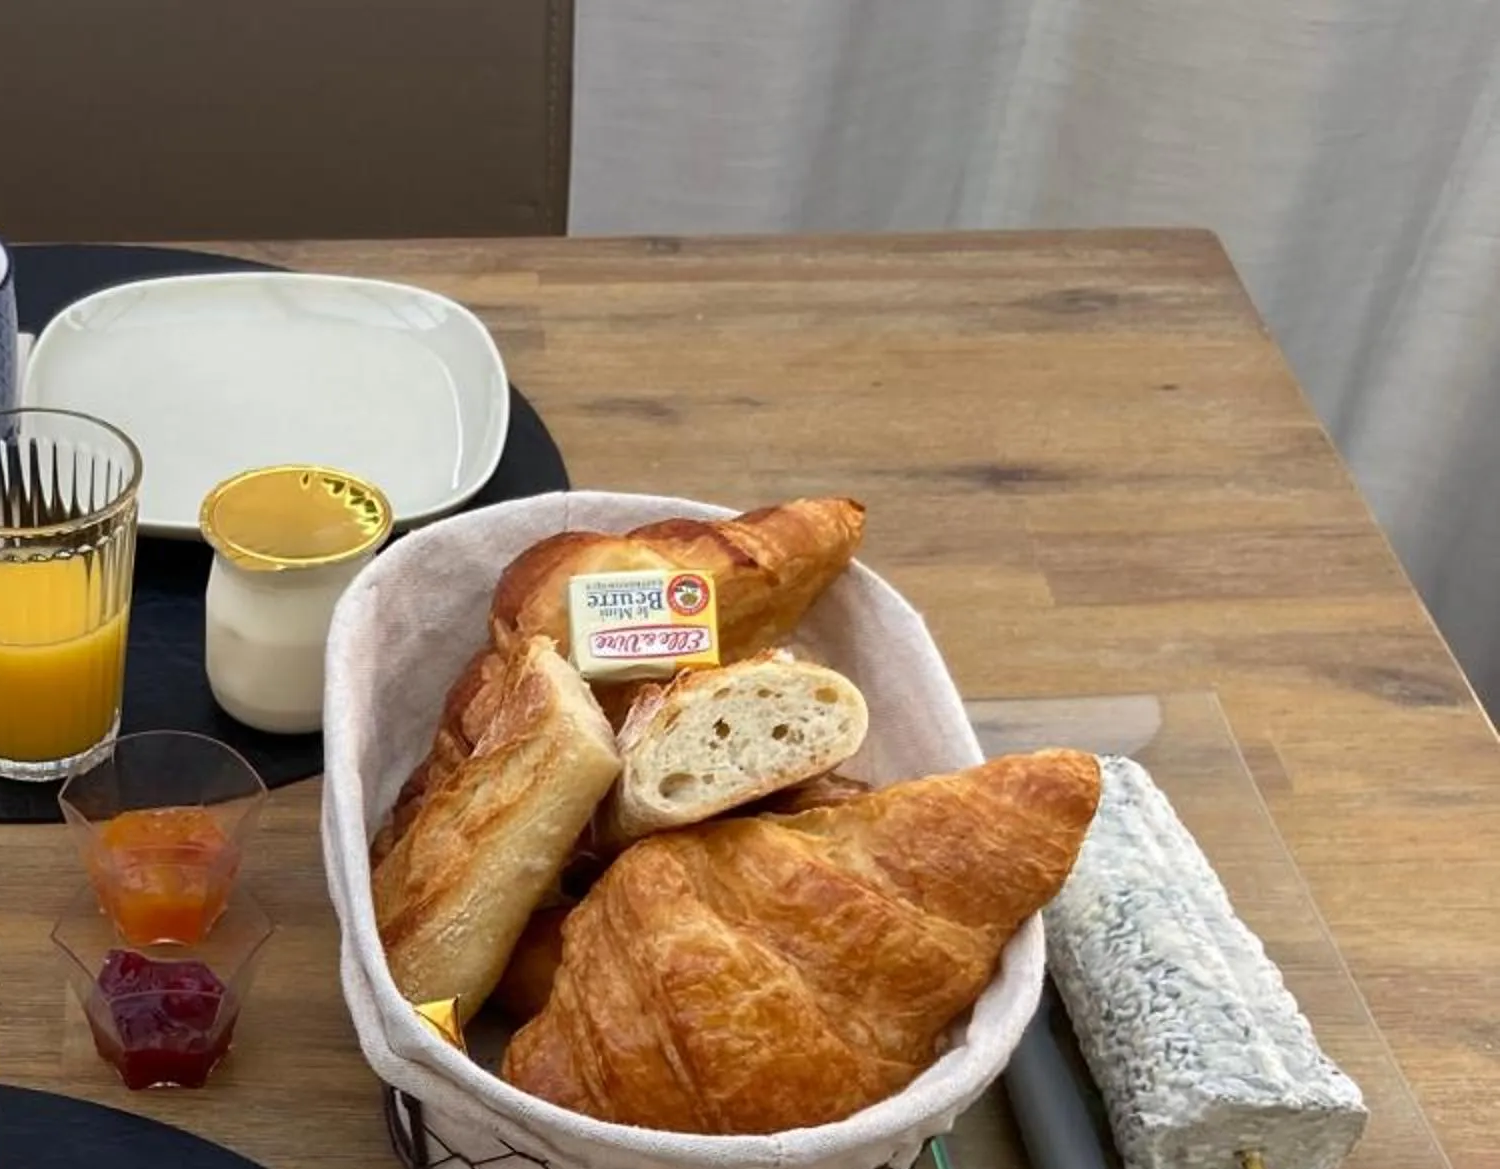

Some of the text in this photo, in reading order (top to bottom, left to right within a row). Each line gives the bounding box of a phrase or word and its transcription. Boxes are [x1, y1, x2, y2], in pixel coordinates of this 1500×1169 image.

[587, 590, 664, 610] Beurre
[595, 630, 704, 653] Elle & Vire
